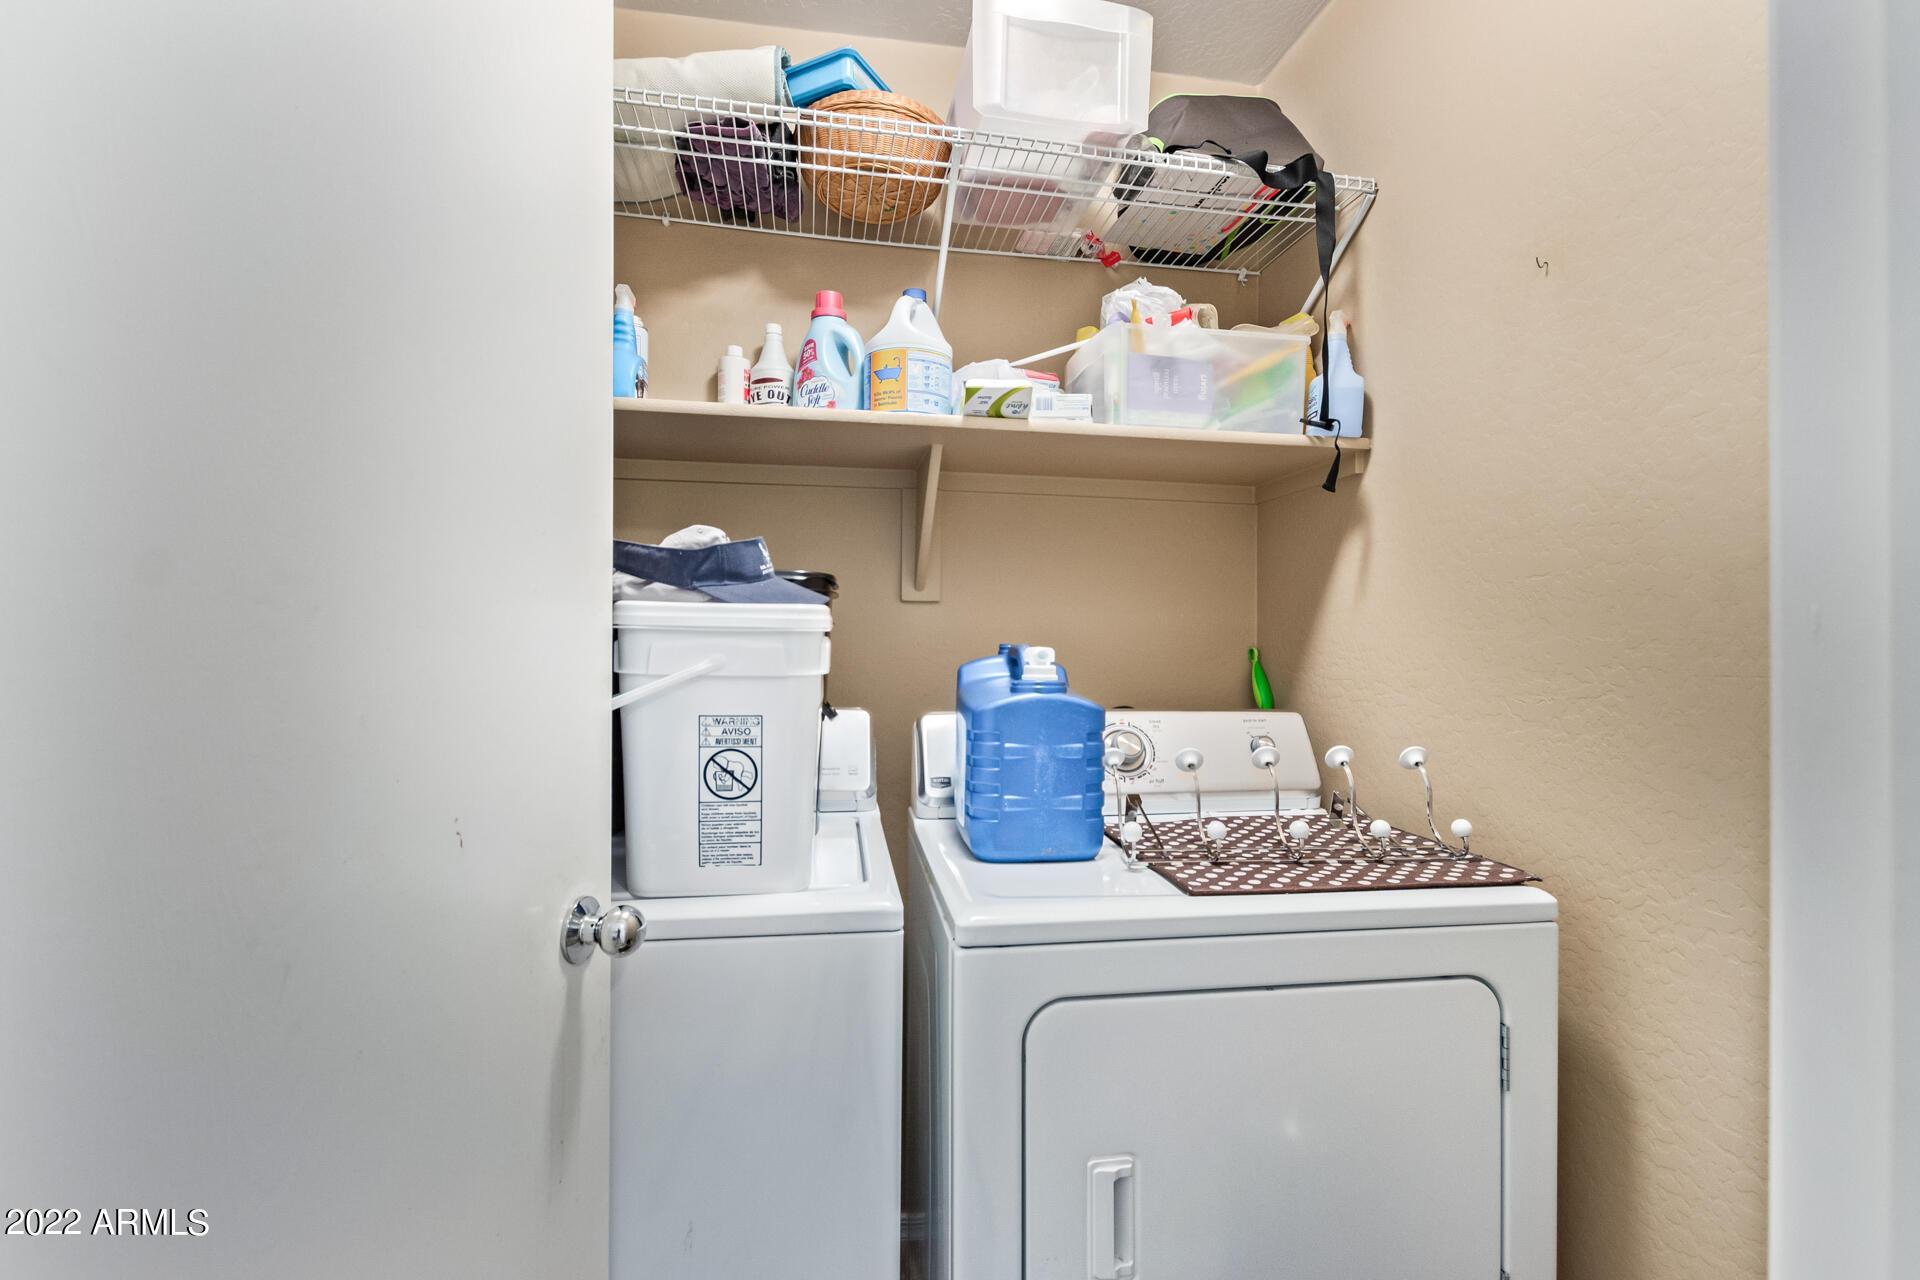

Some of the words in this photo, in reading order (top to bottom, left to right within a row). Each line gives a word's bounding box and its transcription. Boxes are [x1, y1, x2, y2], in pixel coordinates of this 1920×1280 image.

[767, 389, 792, 404] OUT
[800, 382, 830, 398] Cuddle
[804, 394, 821, 408] Soft
[721, 727, 752, 736] AVISO
